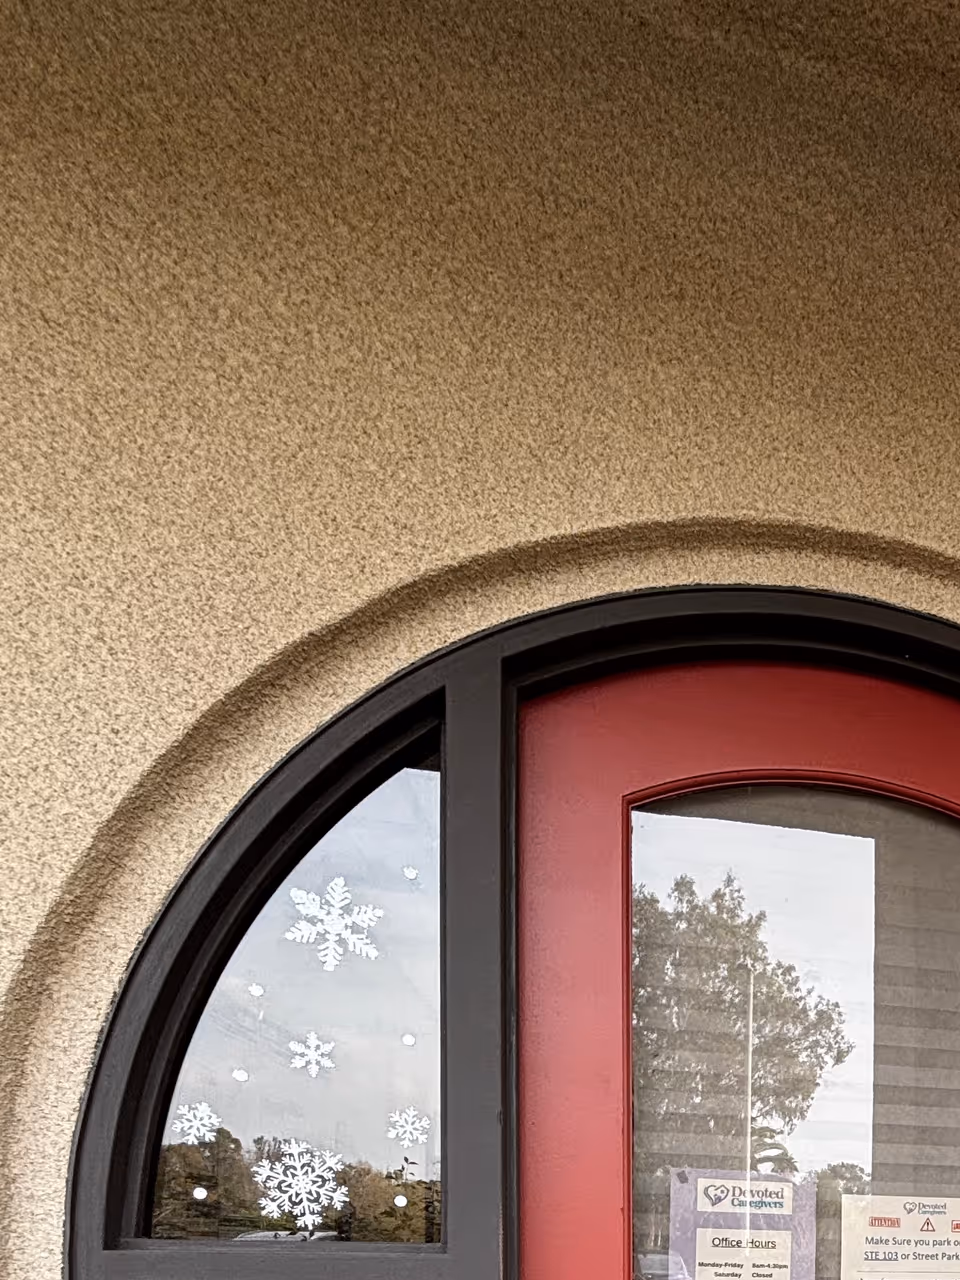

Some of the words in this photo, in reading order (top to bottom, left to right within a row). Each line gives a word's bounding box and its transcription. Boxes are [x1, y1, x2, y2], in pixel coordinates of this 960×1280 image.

[732, 1186, 784, 1199] Devoted
[731, 1198, 784, 1209] Caregivers
[712, 1237, 742, 1248] Office
[747, 1238, 776, 1248] Hours
[865, 1237, 889, 1245] Make
[892, 1237, 911, 1246] Sure
[914, 1239, 929, 1250] you
[932, 1237, 951, 1250] park
[864, 1251, 881, 1261] STE
[883, 1252, 898, 1261] 103
[912, 1252, 938, 1260] Street
